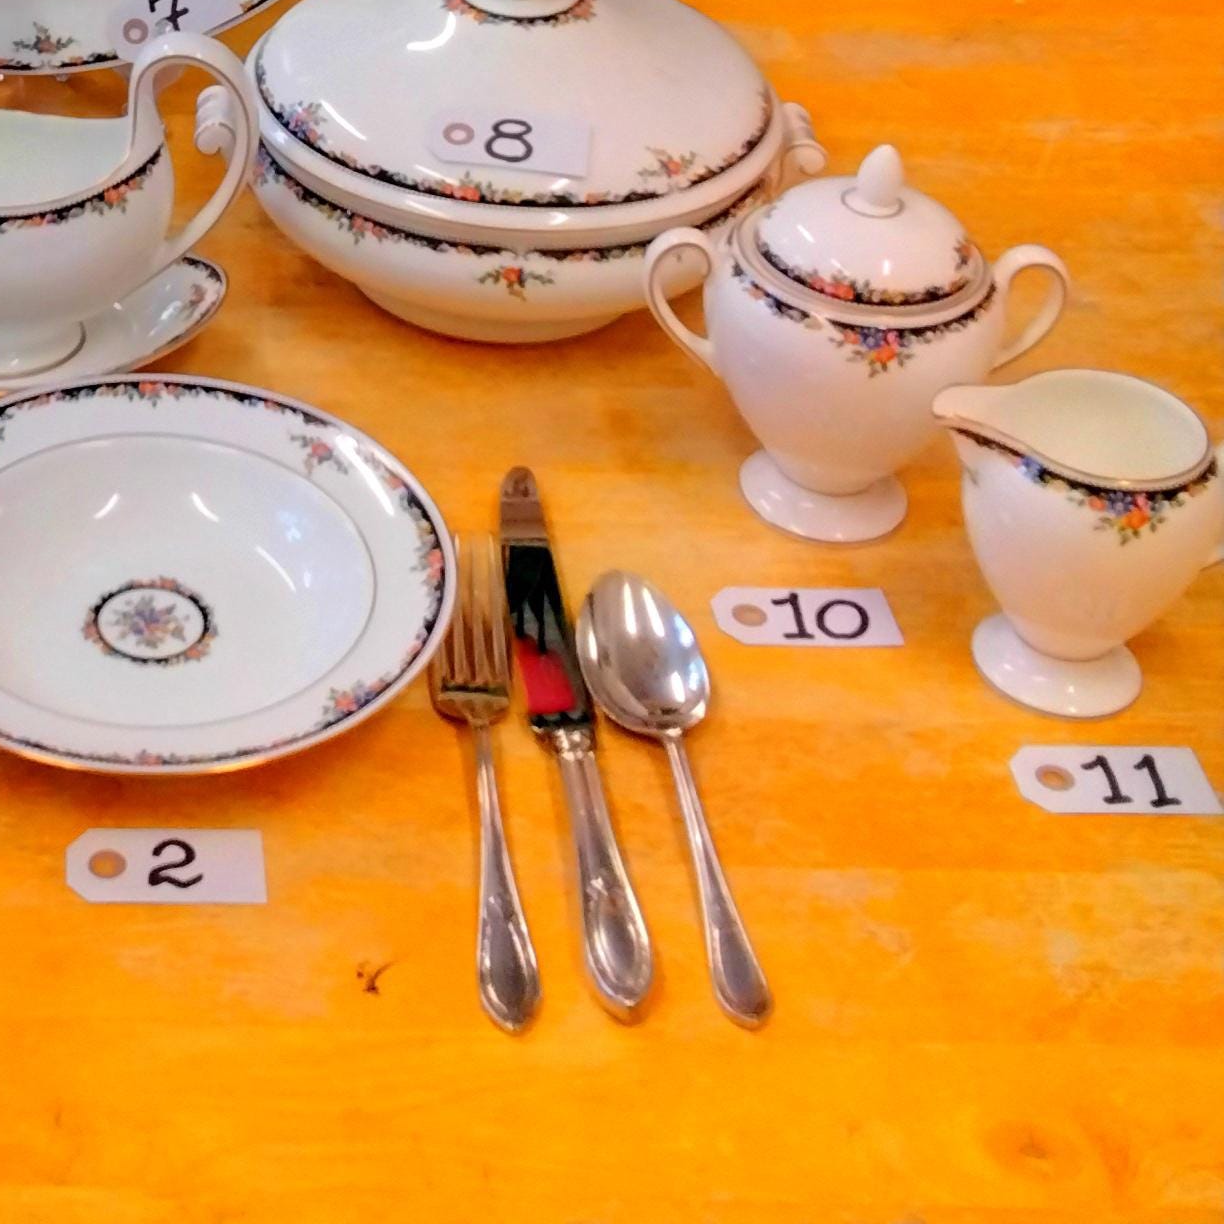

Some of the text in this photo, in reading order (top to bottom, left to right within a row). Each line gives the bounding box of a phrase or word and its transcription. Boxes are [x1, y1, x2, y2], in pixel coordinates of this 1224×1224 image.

[485, 119, 534, 163] 8
[771, 591, 870, 640] 10
[1080, 754, 1182, 809] 11
[147, 838, 204, 889] 2
